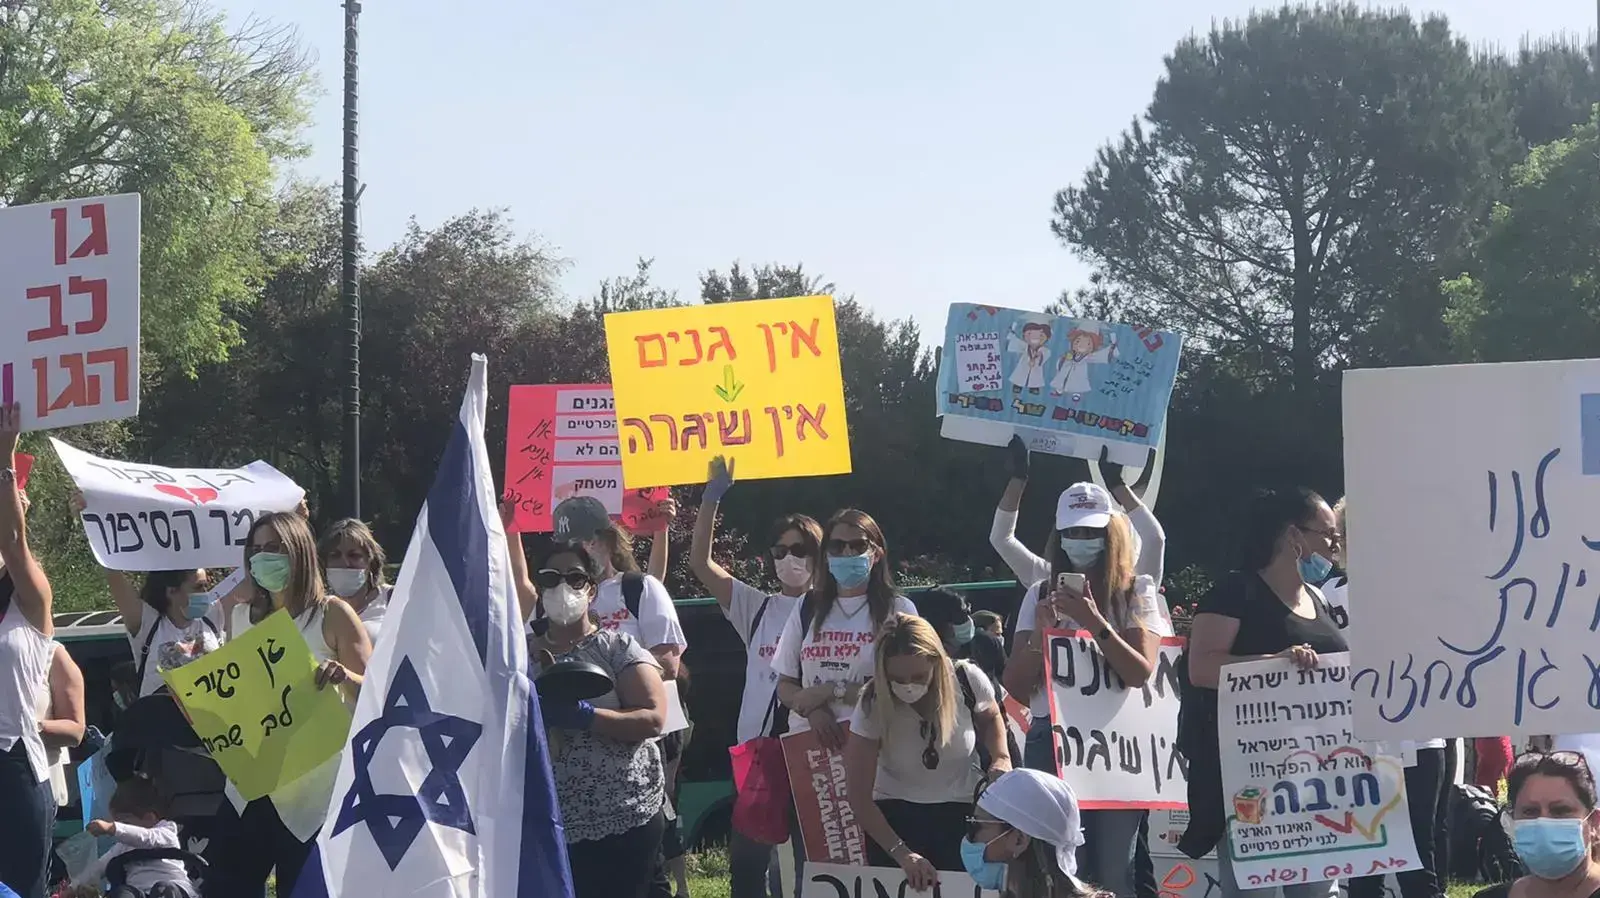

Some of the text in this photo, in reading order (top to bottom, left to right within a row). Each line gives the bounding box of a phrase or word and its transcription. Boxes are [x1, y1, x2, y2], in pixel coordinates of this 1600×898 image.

[51, 203, 108, 265] גן
[26, 276, 108, 342] לב
[634, 318, 821, 373] אין גנים
[32, 347, 129, 417] הגן
[527, 419, 552, 440] אין
[623, 403, 829, 459] אין שיגרה
[521, 444, 550, 465] גנים
[576, 443, 619, 455] הם לא
[186, 473, 255, 491] גן
[516, 466, 544, 484] אין
[574, 479, 617, 492] משחק
[83, 509, 200, 555] הסיפור
[257, 638, 285, 689] גן
[1227, 671, 1288, 692] ישראל
[1351, 645, 1506, 723] לחזור
[1514, 648, 1560, 726] גן
[260, 684, 293, 736] לב
[1238, 737, 1300, 754] בישראל
[1305, 734, 1338, 751] הרך
[1053, 725, 1190, 794] אין שיגרה
[1249, 755, 1372, 780] הוא לא הפקר!!!
[1237, 821, 1313, 838] האיגוד הארצי
[1240, 832, 1338, 854] לגני ילדים פרטיים
